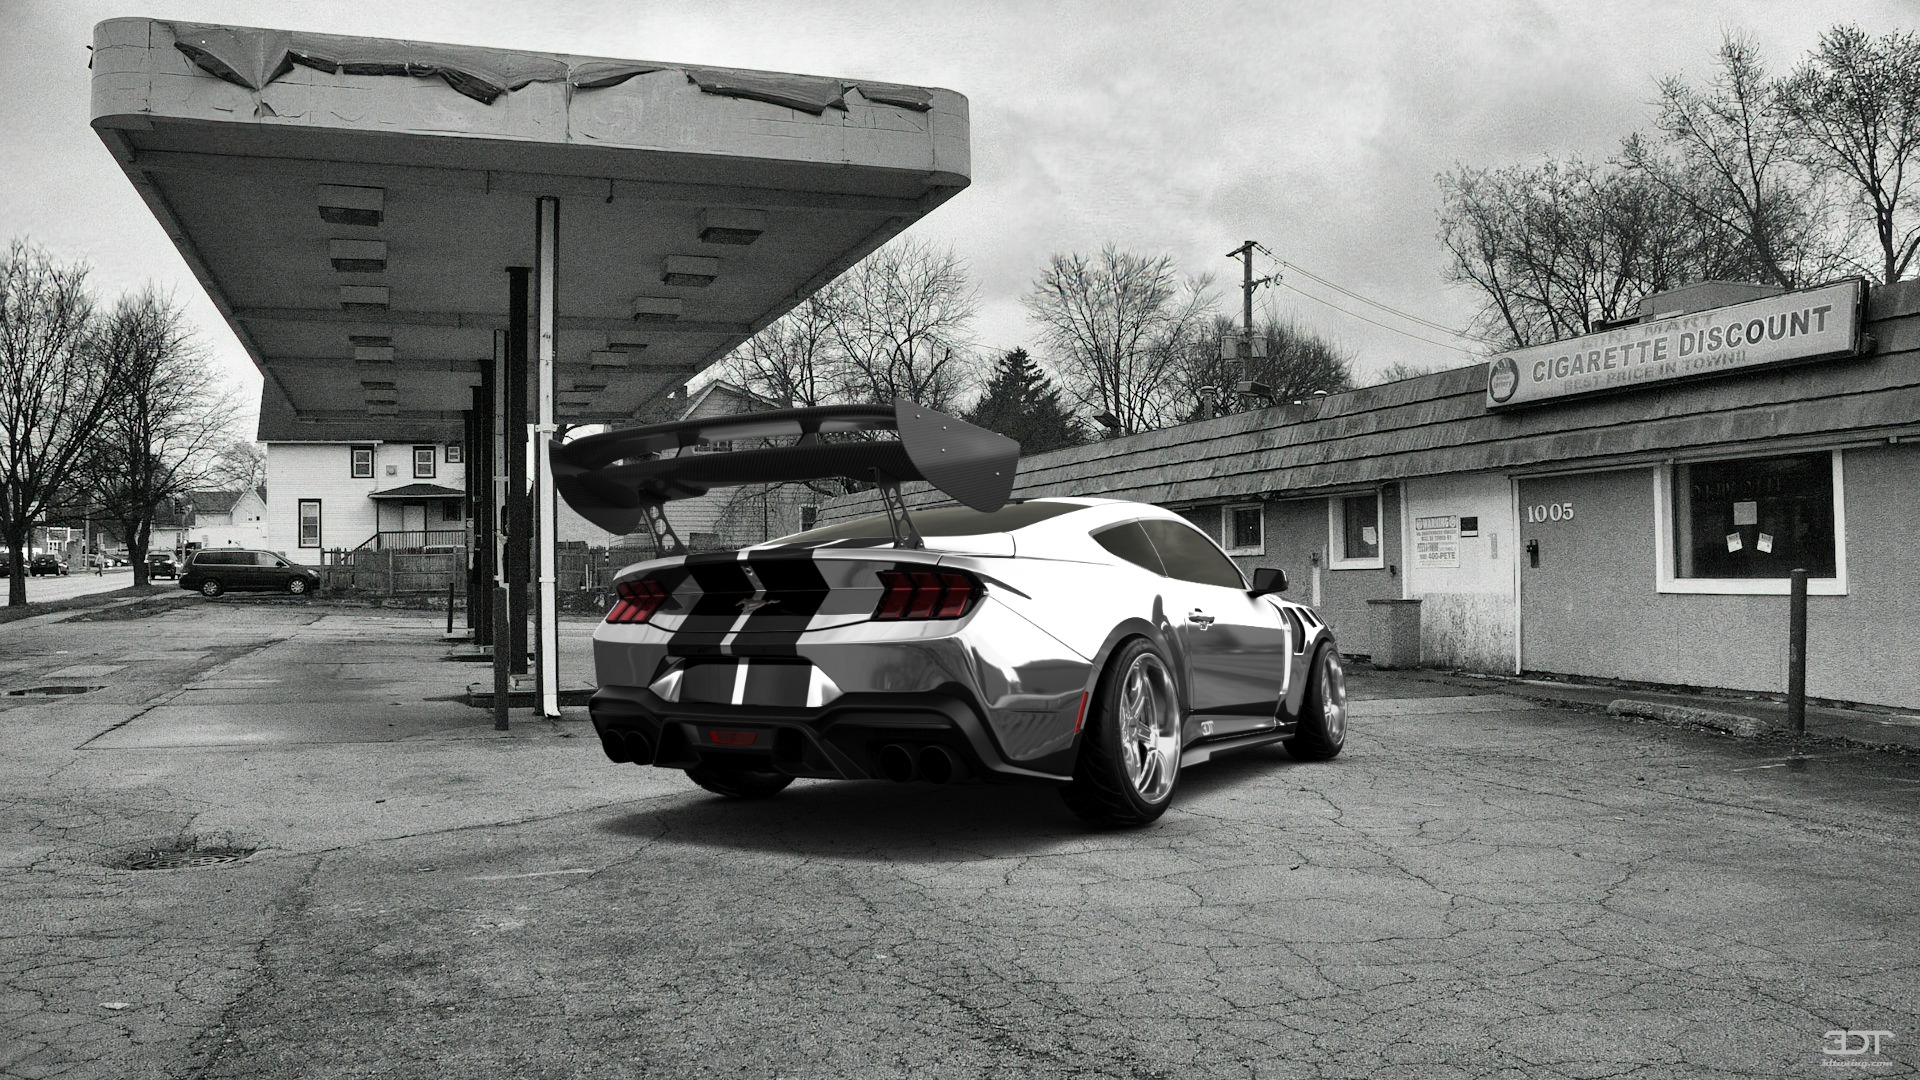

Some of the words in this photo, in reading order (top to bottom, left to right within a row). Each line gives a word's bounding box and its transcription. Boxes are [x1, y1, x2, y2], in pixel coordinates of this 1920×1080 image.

[1644, 313, 1715, 335] MART
[1532, 336, 1669, 383] CIGARETTE
[1679, 304, 1833, 357] DISCOUNT
[1564, 376, 1600, 393] BEST
[1606, 365, 1654, 386] PRICE
[1659, 362, 1677, 376] IN
[1527, 502, 1574, 523] 1005
